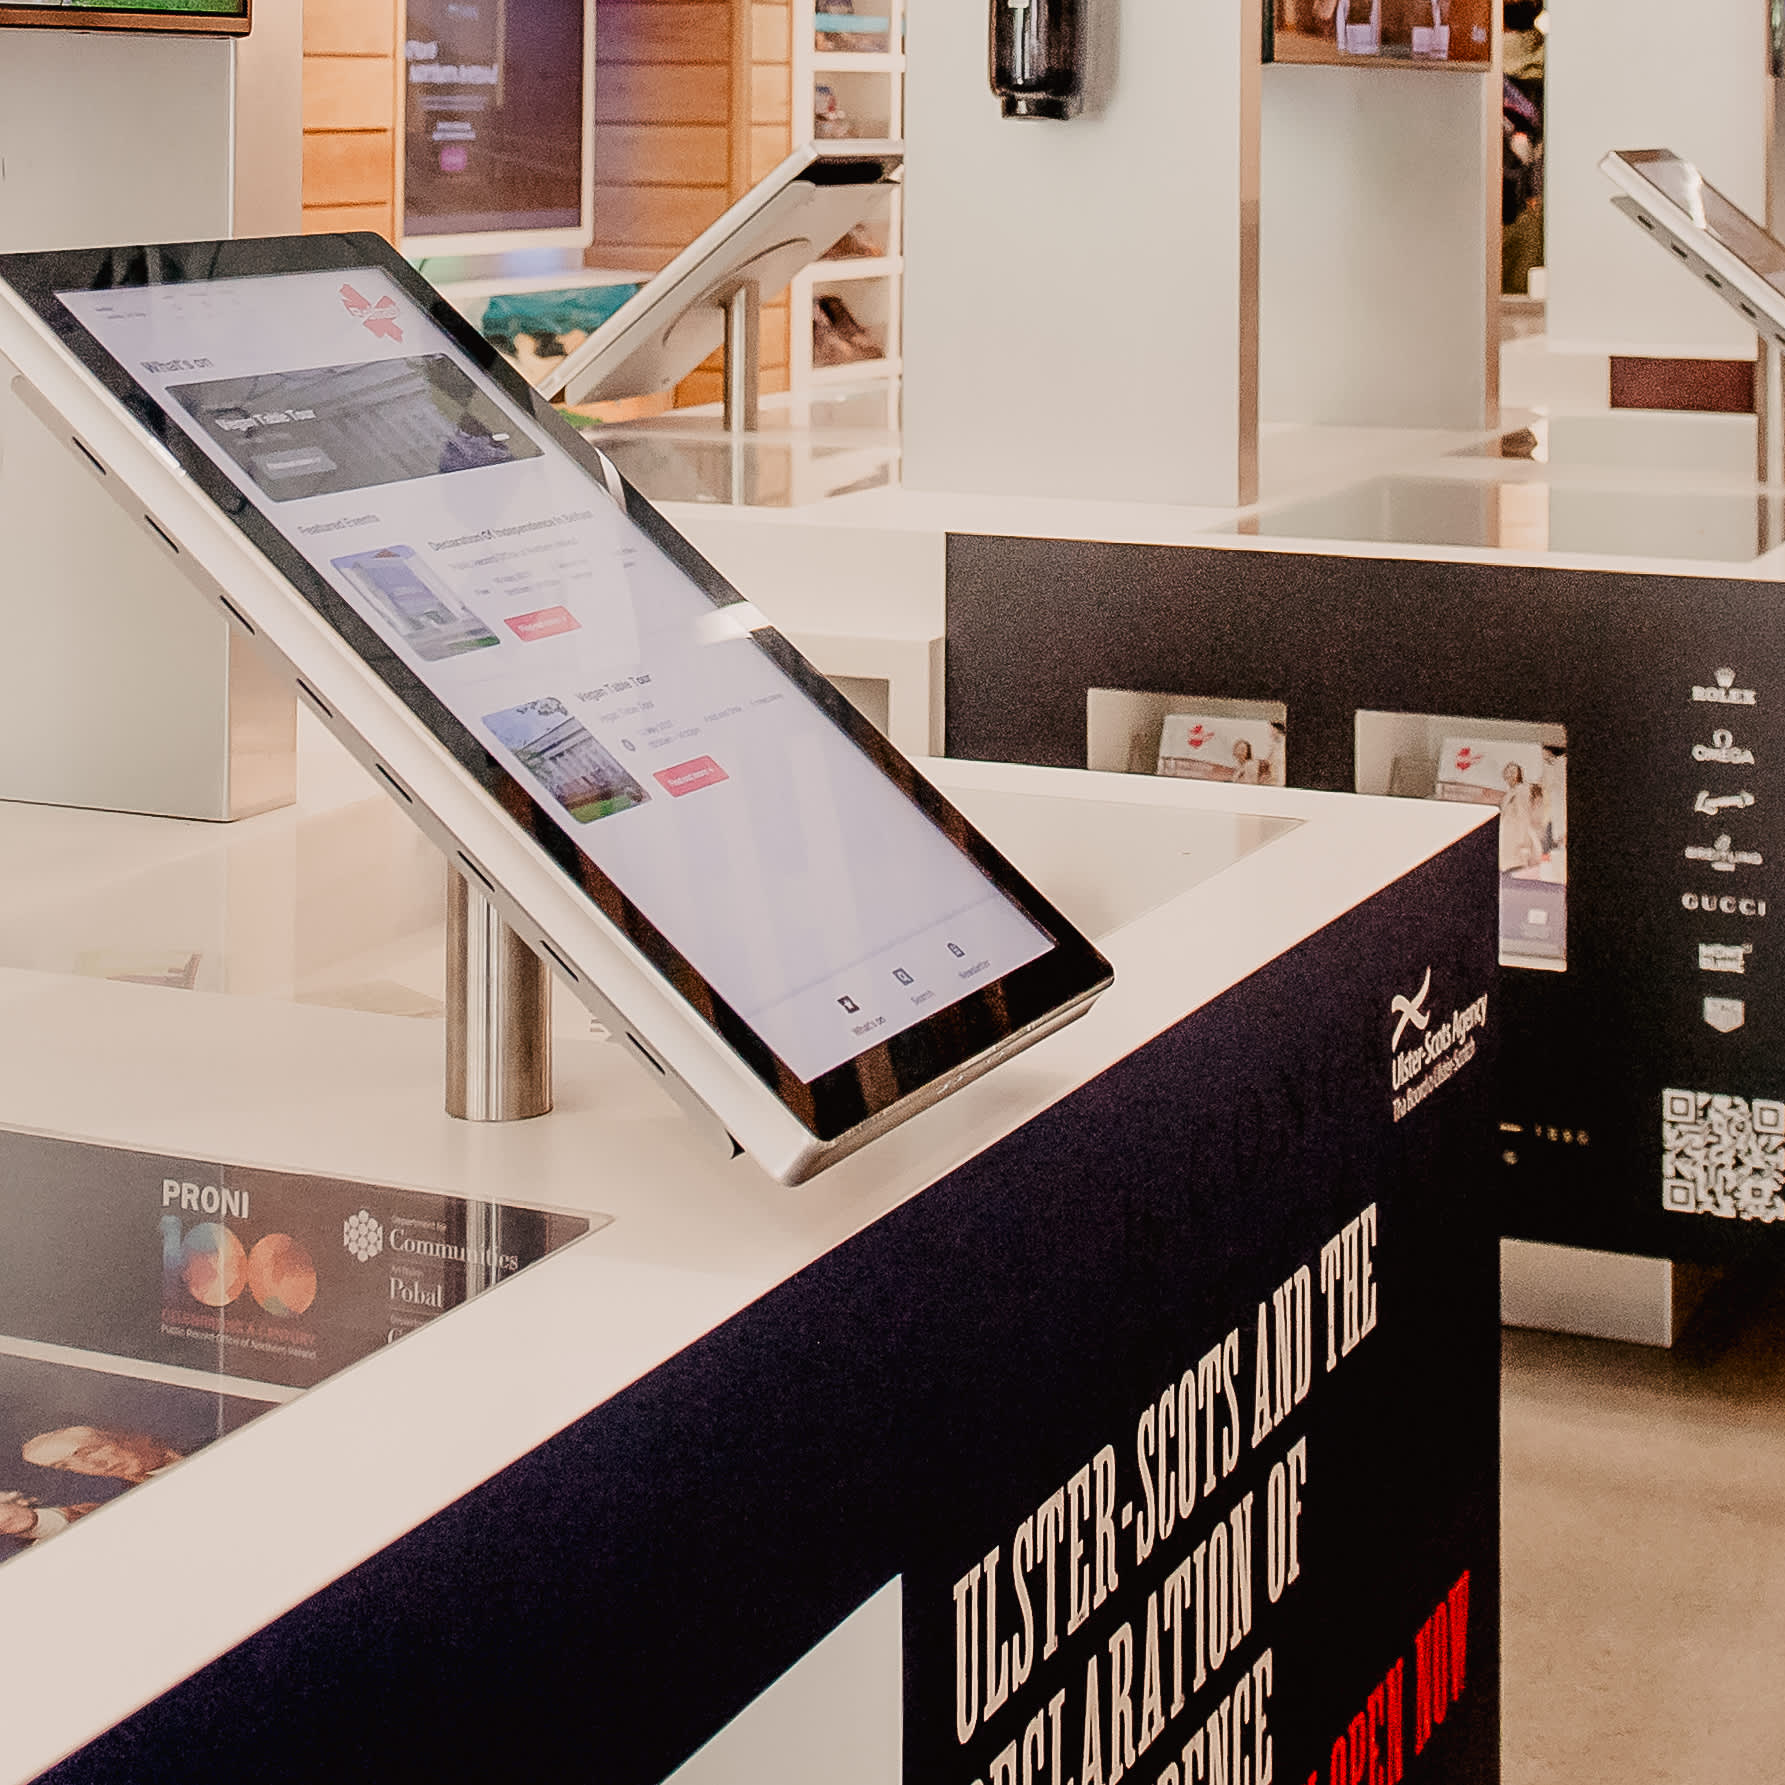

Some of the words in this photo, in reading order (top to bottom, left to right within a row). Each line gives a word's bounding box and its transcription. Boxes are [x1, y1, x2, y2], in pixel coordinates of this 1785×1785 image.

[1691, 685, 1757, 705] ROLEX
[1691, 744, 1756, 765] OMEGA
[1681, 892, 1766, 917] GUCCI
[1392, 1023, 1452, 1091] Ulster-Scots
[161, 1179, 250, 1219] PRONI
[389, 1276, 443, 1309] Pobal
[951, 1328, 1241, 1746] ULSTER-SCOTS
[1250, 1263, 1311, 1449] AND
[1320, 1201, 1377, 1374] THE
[968, 1489, 1253, 1785] CLARATION
[1266, 1435, 1308, 1605] OF
[1414, 1569, 1471, 1756] NOW
